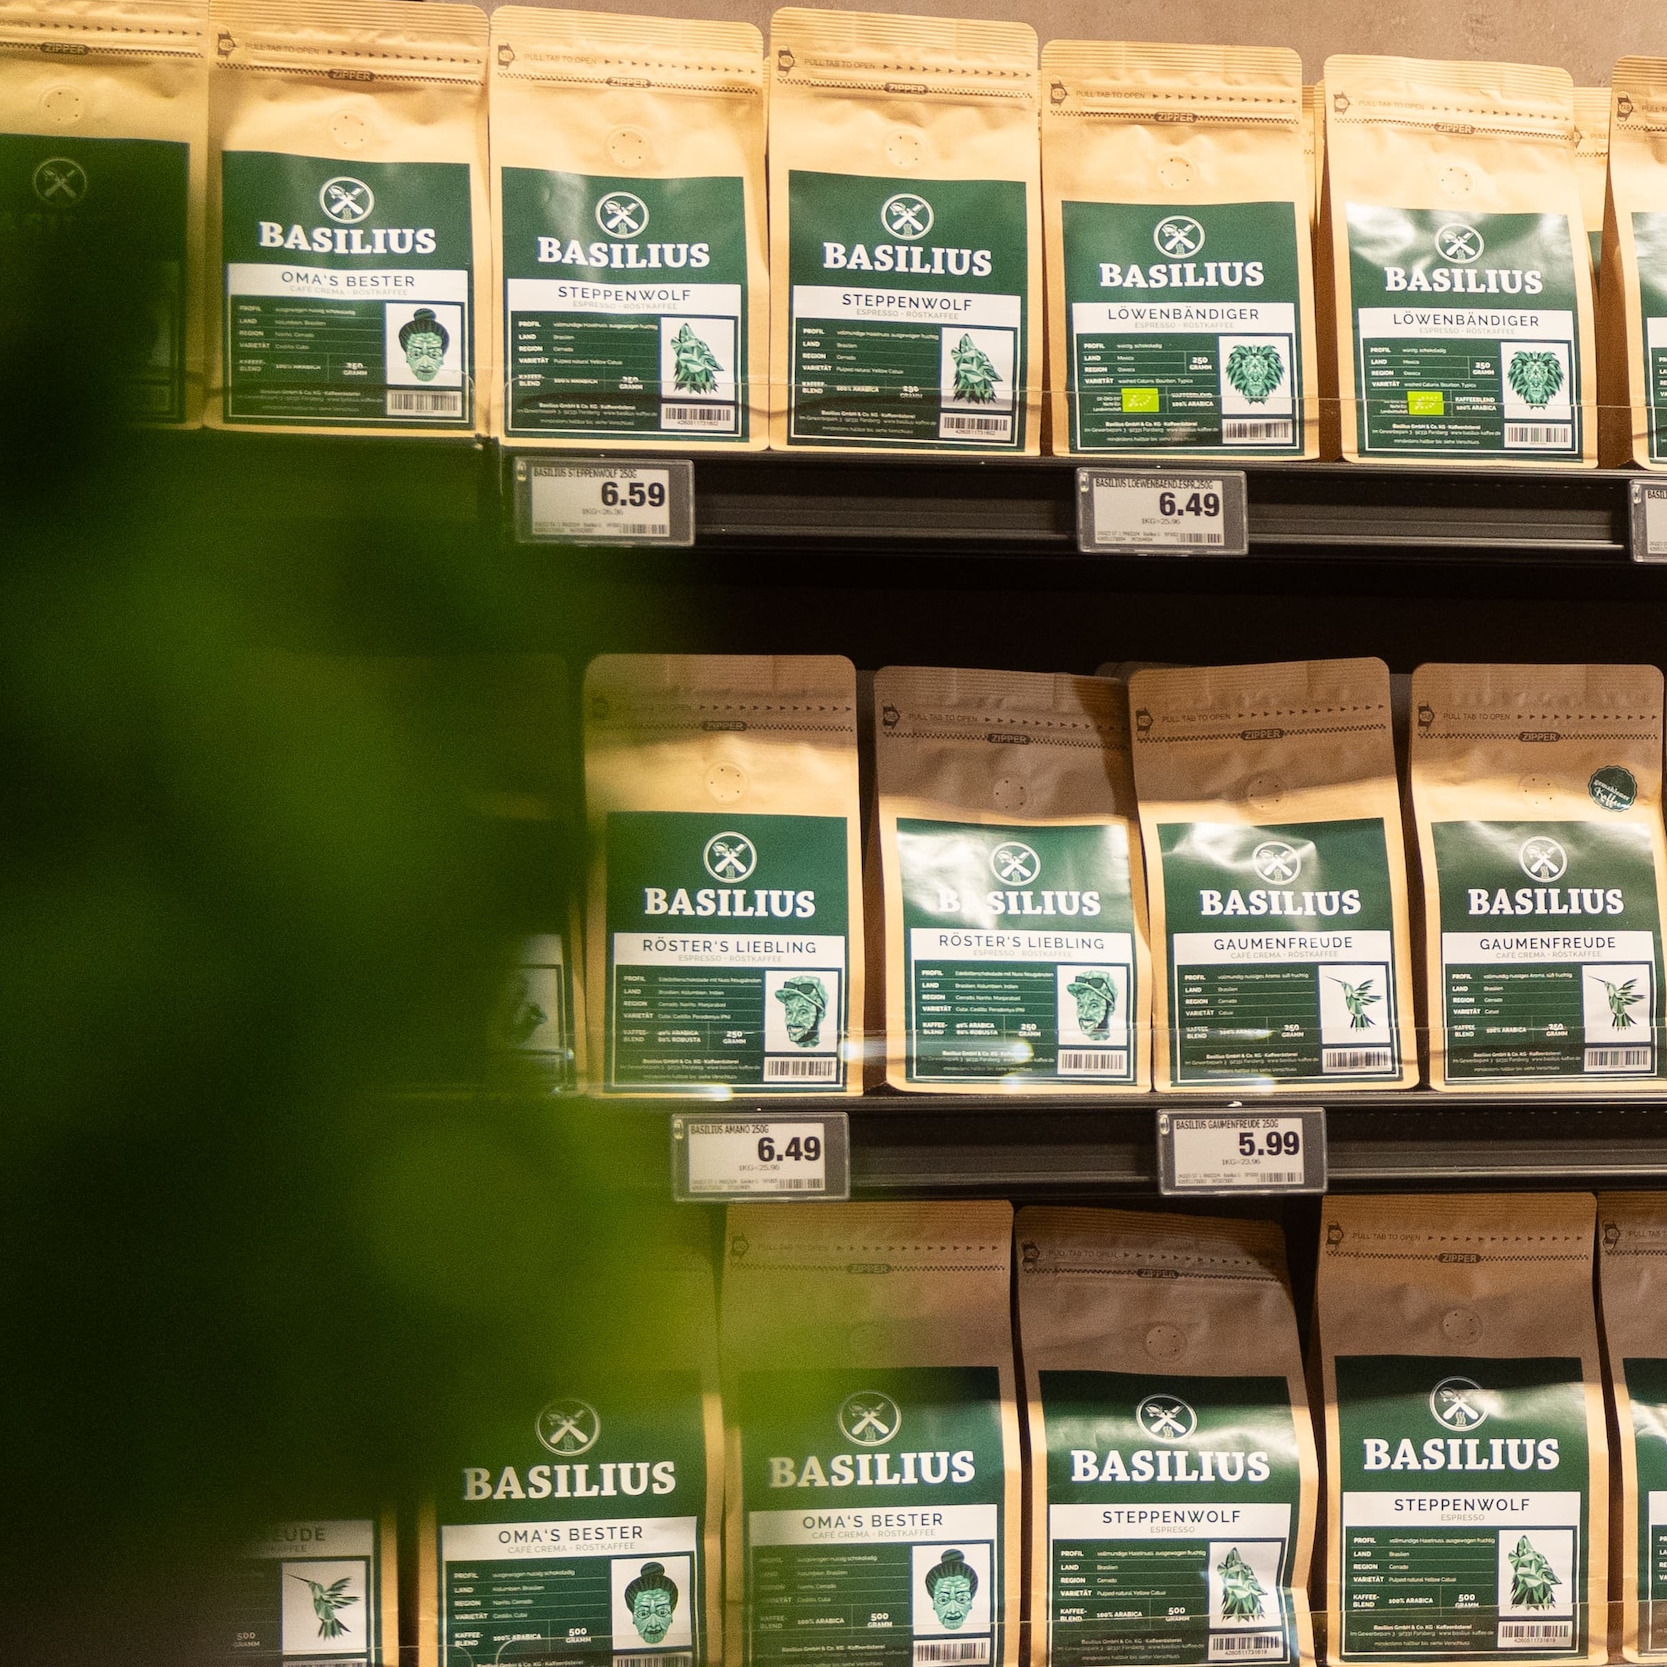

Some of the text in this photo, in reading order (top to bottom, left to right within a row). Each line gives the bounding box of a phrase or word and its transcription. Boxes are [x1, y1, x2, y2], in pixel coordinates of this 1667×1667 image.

[259, 222, 436, 256] BASILIUS
[538, 237, 711, 270] BASILIUS
[824, 242, 992, 277] BASILIUS
[281, 271, 416, 289] OMA'S BESTER
[1099, 261, 1264, 288] BASILIUS
[1385, 266, 1542, 296] BASILIUS
[558, 286, 692, 302] STEPPENWOLF
[842, 293, 972, 312] STEPPENWOLF
[1108, 306, 1258, 322] LÖWENBÄNDIGER
[1394, 310, 1539, 328] LÖWENBÄNDIGER
[601, 481, 666, 508] 6.59
[1159, 491, 1220, 517] 6.49
[645, 888, 815, 918] BASILIUS
[1200, 889, 1360, 916] BASILIUS
[1468, 888, 1624, 916] BASILIUS
[739, 937, 816, 954] LIEBLING
[1028, 934, 1104, 950] LIEBLING
[1214, 936, 1353, 951] GAUMENFREUDE
[1479, 934, 1616, 951] GAUMENFREUDE
[758, 1136, 821, 1162] 6.49
[1239, 1131, 1300, 1156] 5.99
[1441, 1254, 1479, 1263] ZIPPER
[1072, 1449, 1270, 1483] BASILIUS
[1364, 1438, 1559, 1471] BASILIUS
[463, 1461, 676, 1501] BASILIUS
[769, 1450, 975, 1488] BASILIUS
[1103, 1510, 1241, 1524] STEPPENWOLF
[1395, 1498, 1530, 1512] STEPPENWOLF
[498, 1525, 644, 1543] OMA'S BESTER
[802, 1513, 944, 1530] OMA'S BESTER
